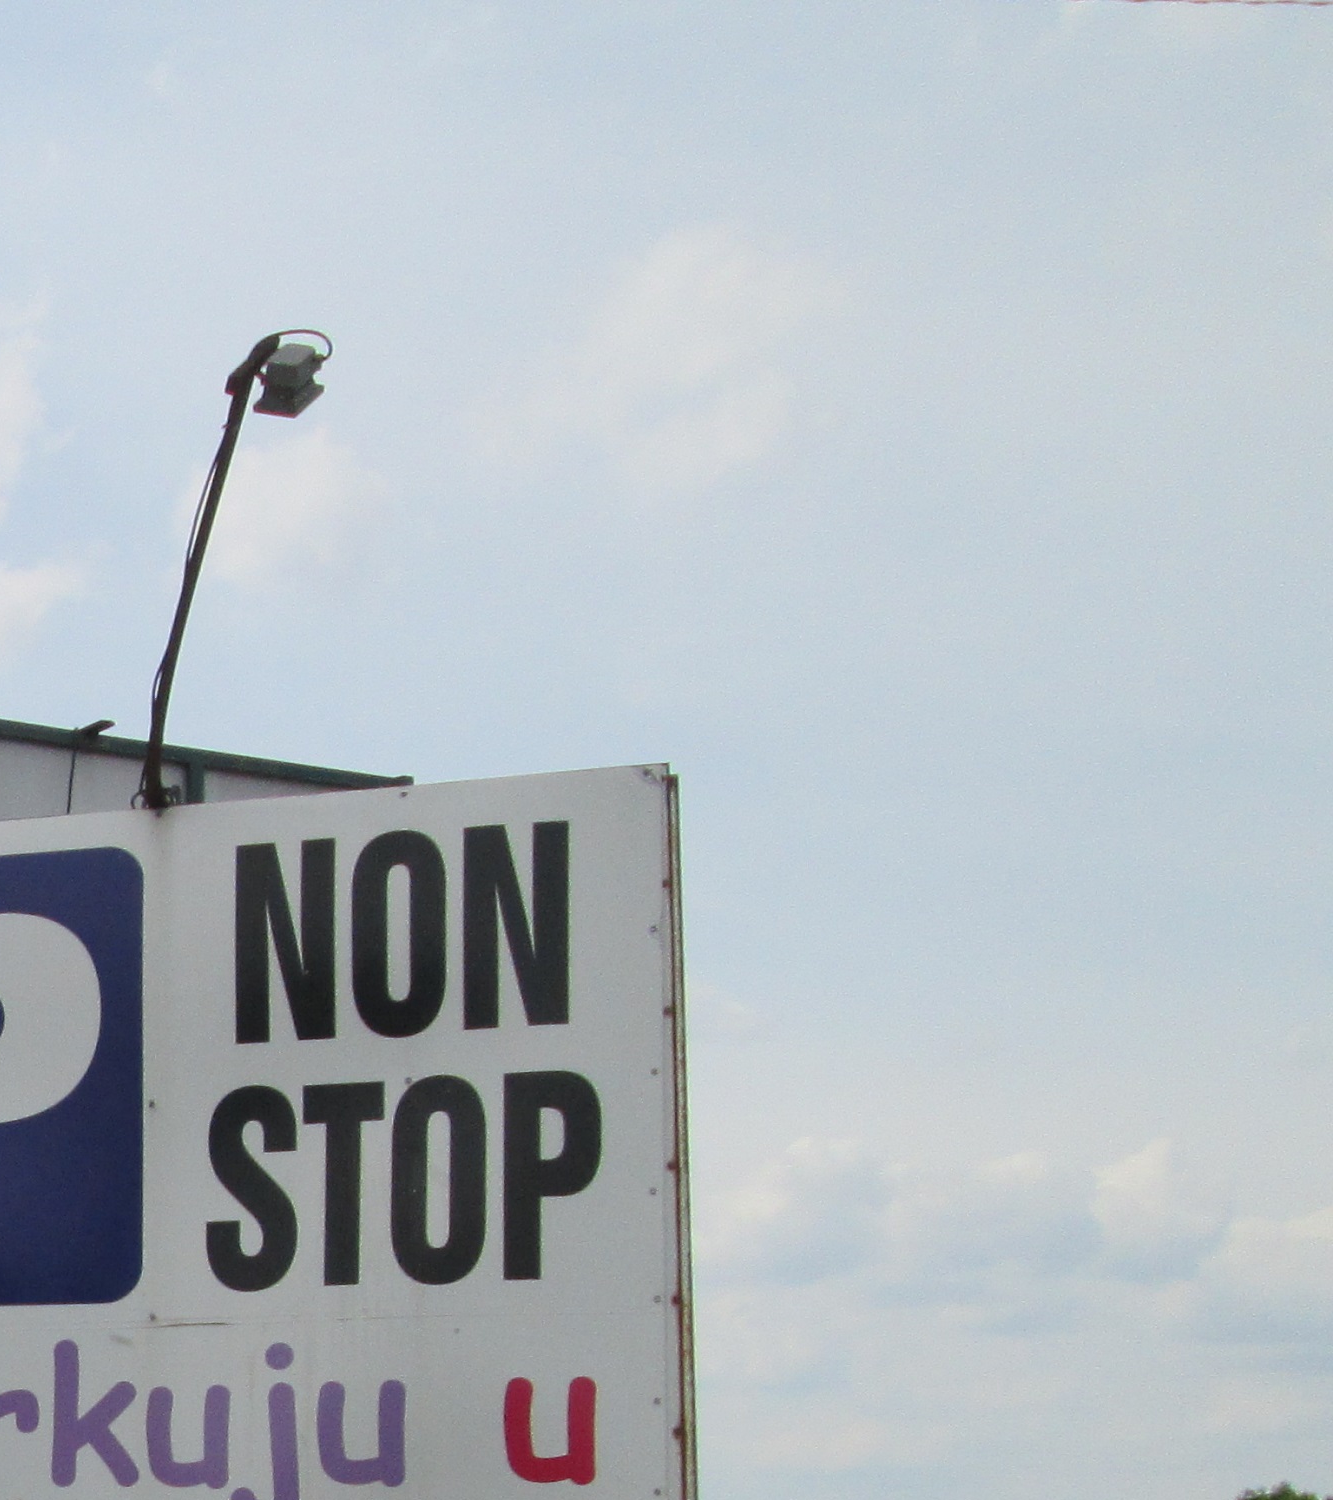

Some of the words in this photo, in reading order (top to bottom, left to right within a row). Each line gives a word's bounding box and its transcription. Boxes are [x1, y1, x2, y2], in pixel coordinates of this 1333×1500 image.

[234, 819, 570, 1045] NON
[205, 1069, 603, 1293] STOP
[502, 1375, 598, 1486] u
